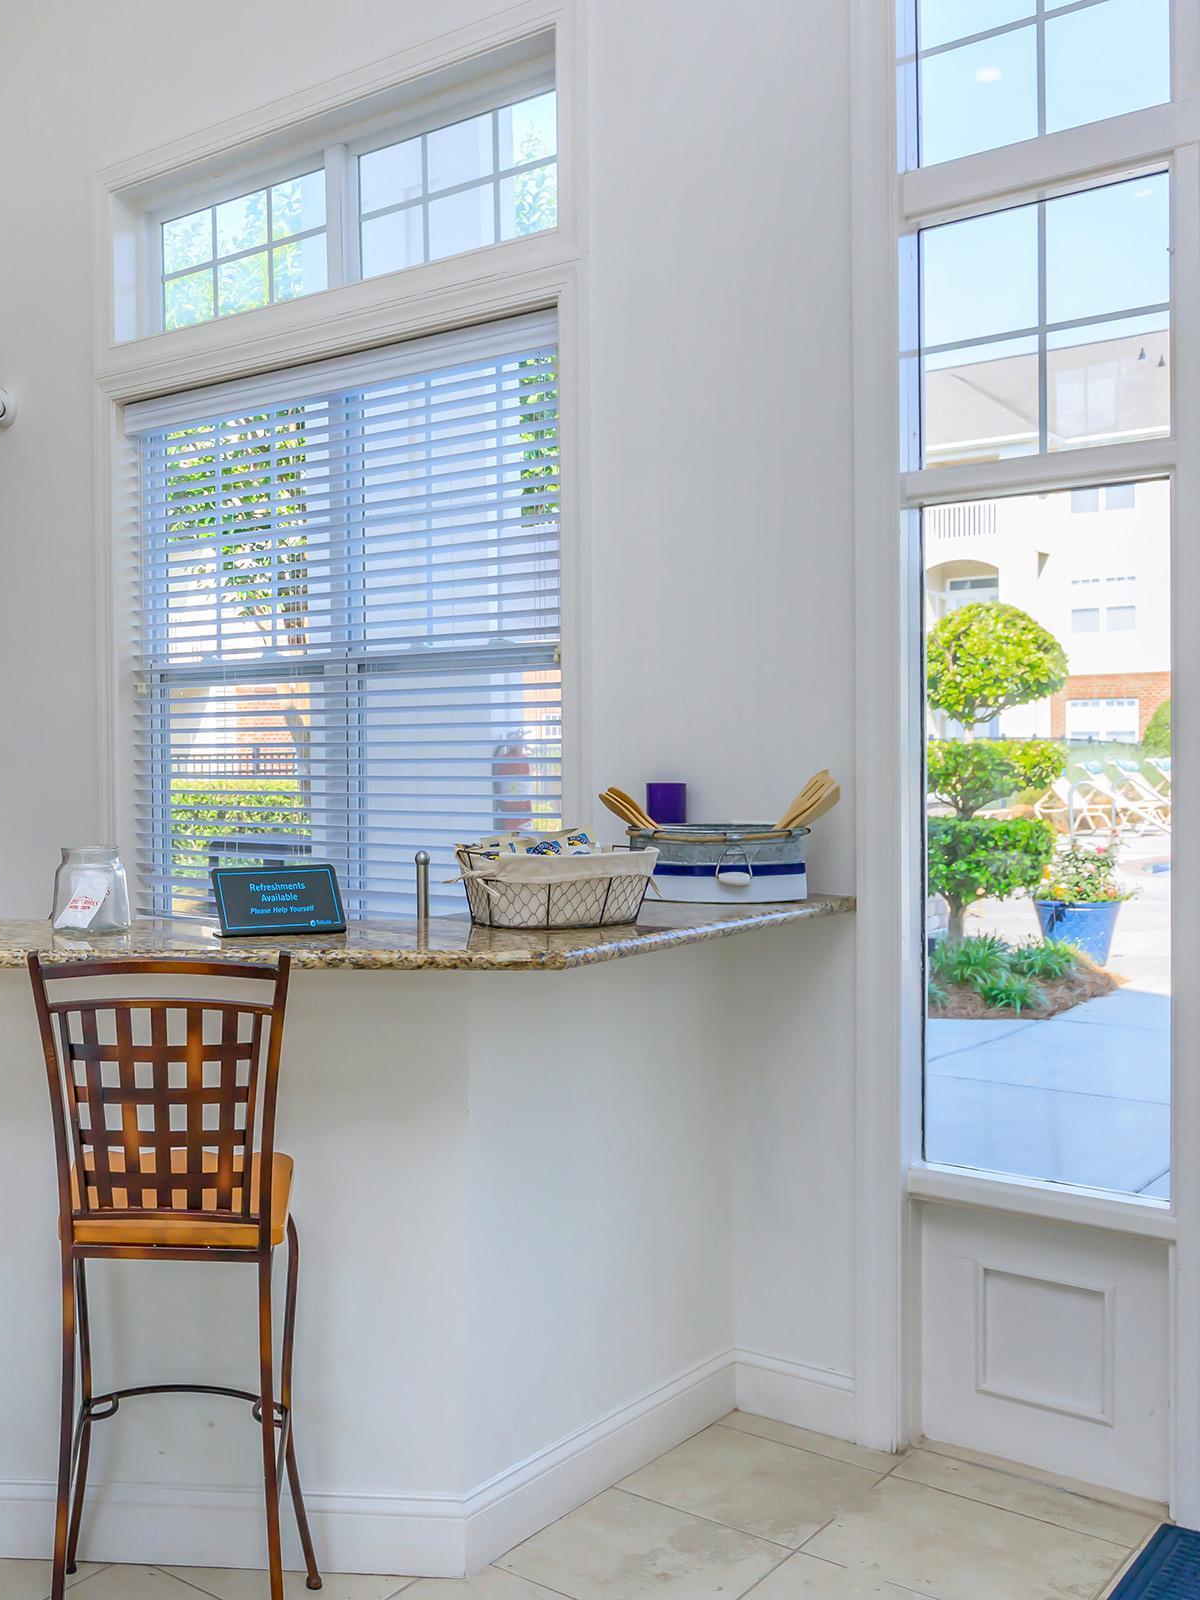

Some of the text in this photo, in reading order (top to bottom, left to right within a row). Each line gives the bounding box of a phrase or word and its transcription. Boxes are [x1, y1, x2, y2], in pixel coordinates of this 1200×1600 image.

[249, 882, 305, 892] Refreshments
[261, 893, 298, 902] Available
[272, 906, 288, 914] Help
[289, 905, 315, 913] Yourself
